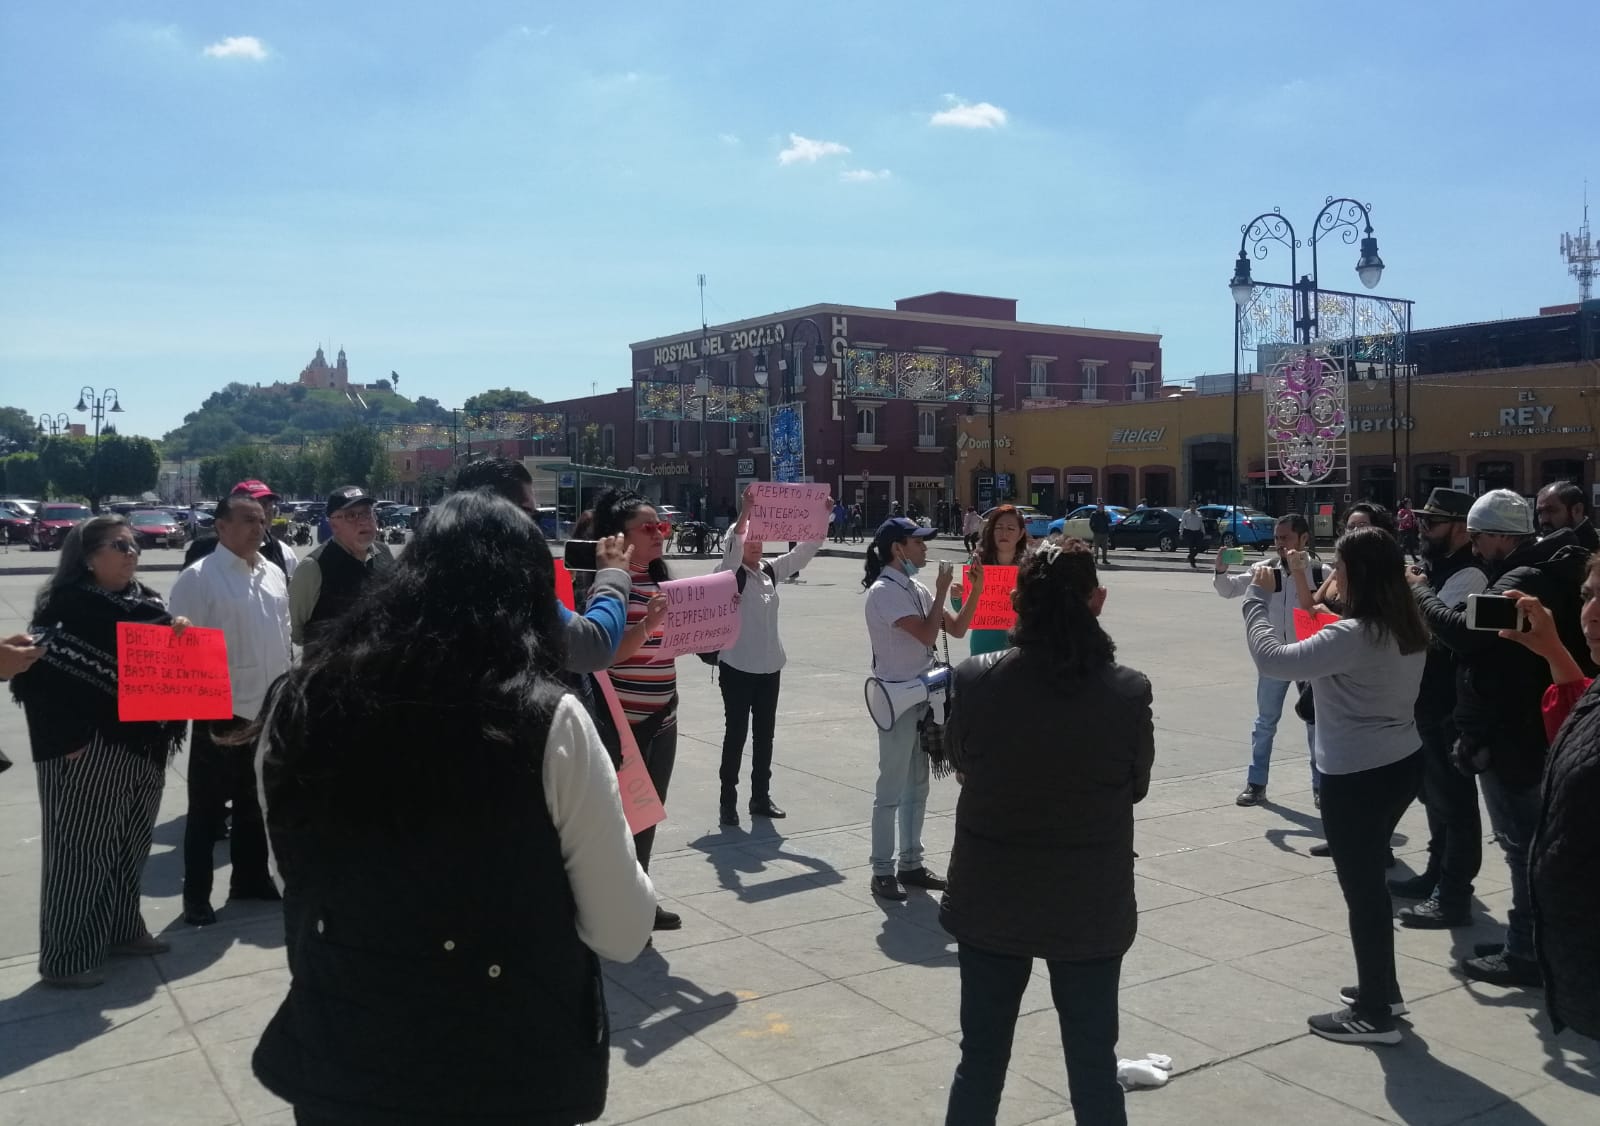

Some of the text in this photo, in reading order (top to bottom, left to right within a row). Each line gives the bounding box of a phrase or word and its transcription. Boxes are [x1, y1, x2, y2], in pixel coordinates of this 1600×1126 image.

[654, 323, 785, 366] HOSTAL DEL ZOCALO
[831, 316, 848, 421] HOTEL
[1518, 391, 1536, 401] EL
[1500, 406, 1553, 426] REY
[1120, 426, 1166, 443] telcel
[650, 461, 690, 476] Scotiabank
[757, 485, 825, 501] RESPETO A LA
[667, 586, 705, 606] NO A LA
[719, 604, 728, 618] DE
[664, 632, 691, 649] LIBRE
[123, 664, 158, 679] BASTA
